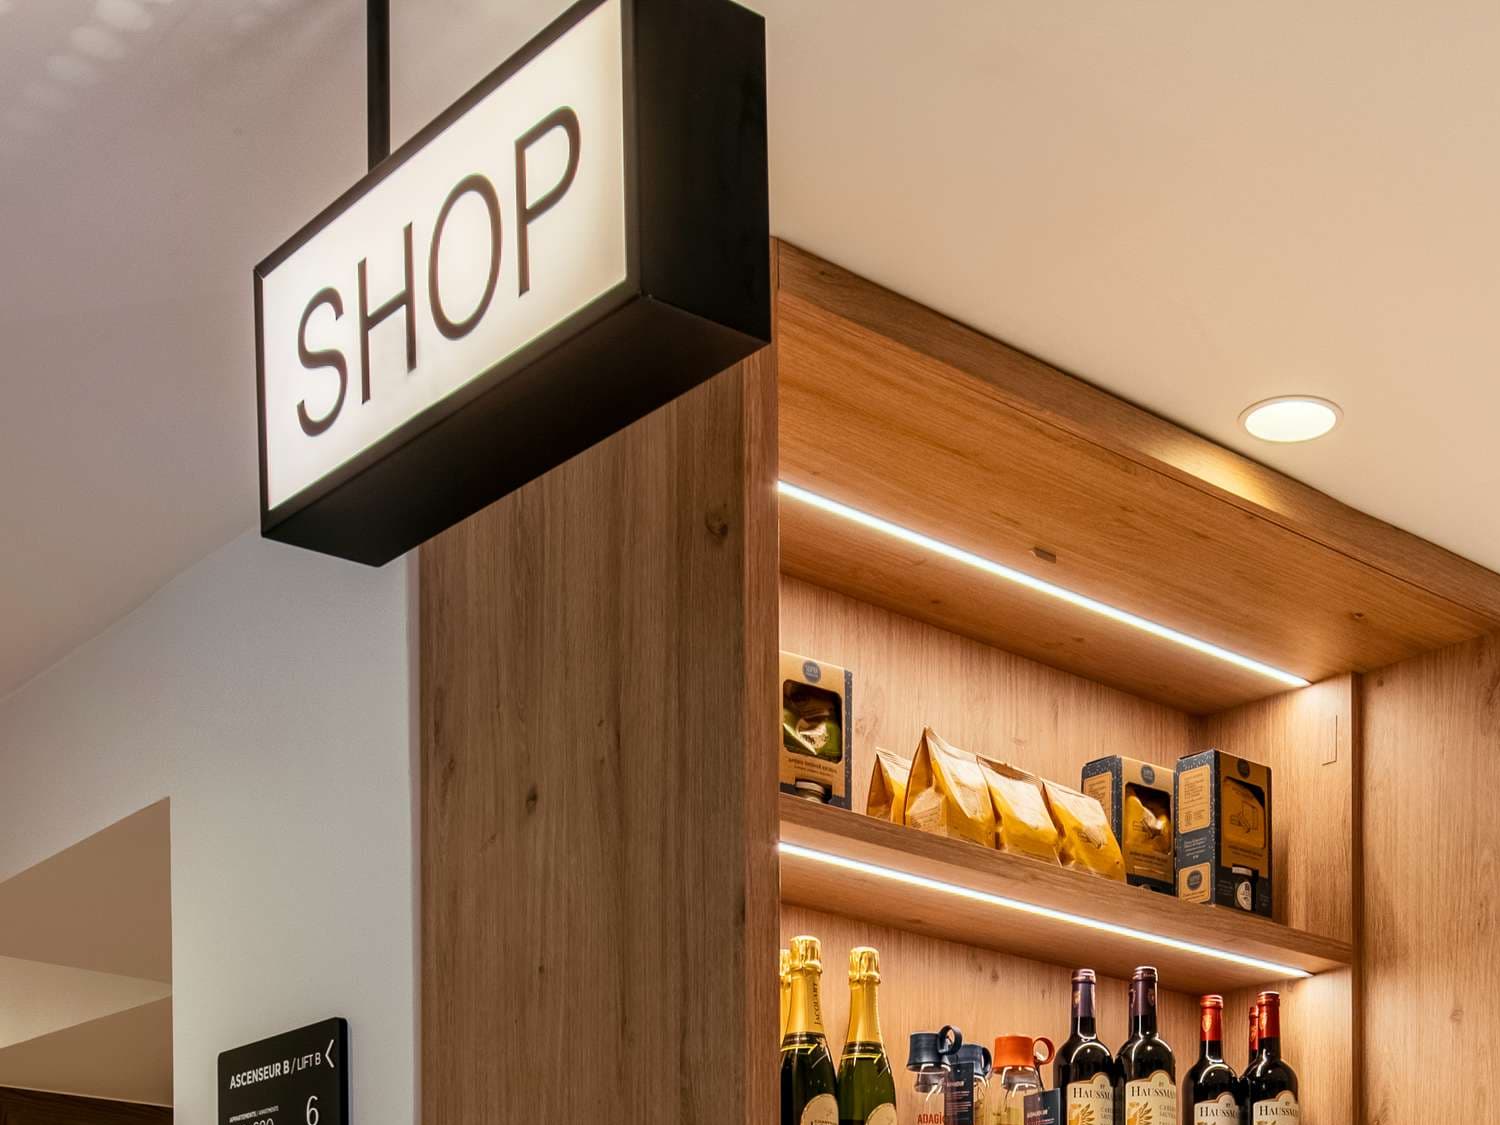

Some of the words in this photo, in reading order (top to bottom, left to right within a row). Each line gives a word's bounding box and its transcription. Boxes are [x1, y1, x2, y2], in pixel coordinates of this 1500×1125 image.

[296, 104, 582, 438] SHOP
[229, 1062, 281, 1090] ASCENSEUR
[283, 1060, 290, 1075] B
[297, 1054, 314, 1071] LIFT
[314, 1052, 321, 1066] B
